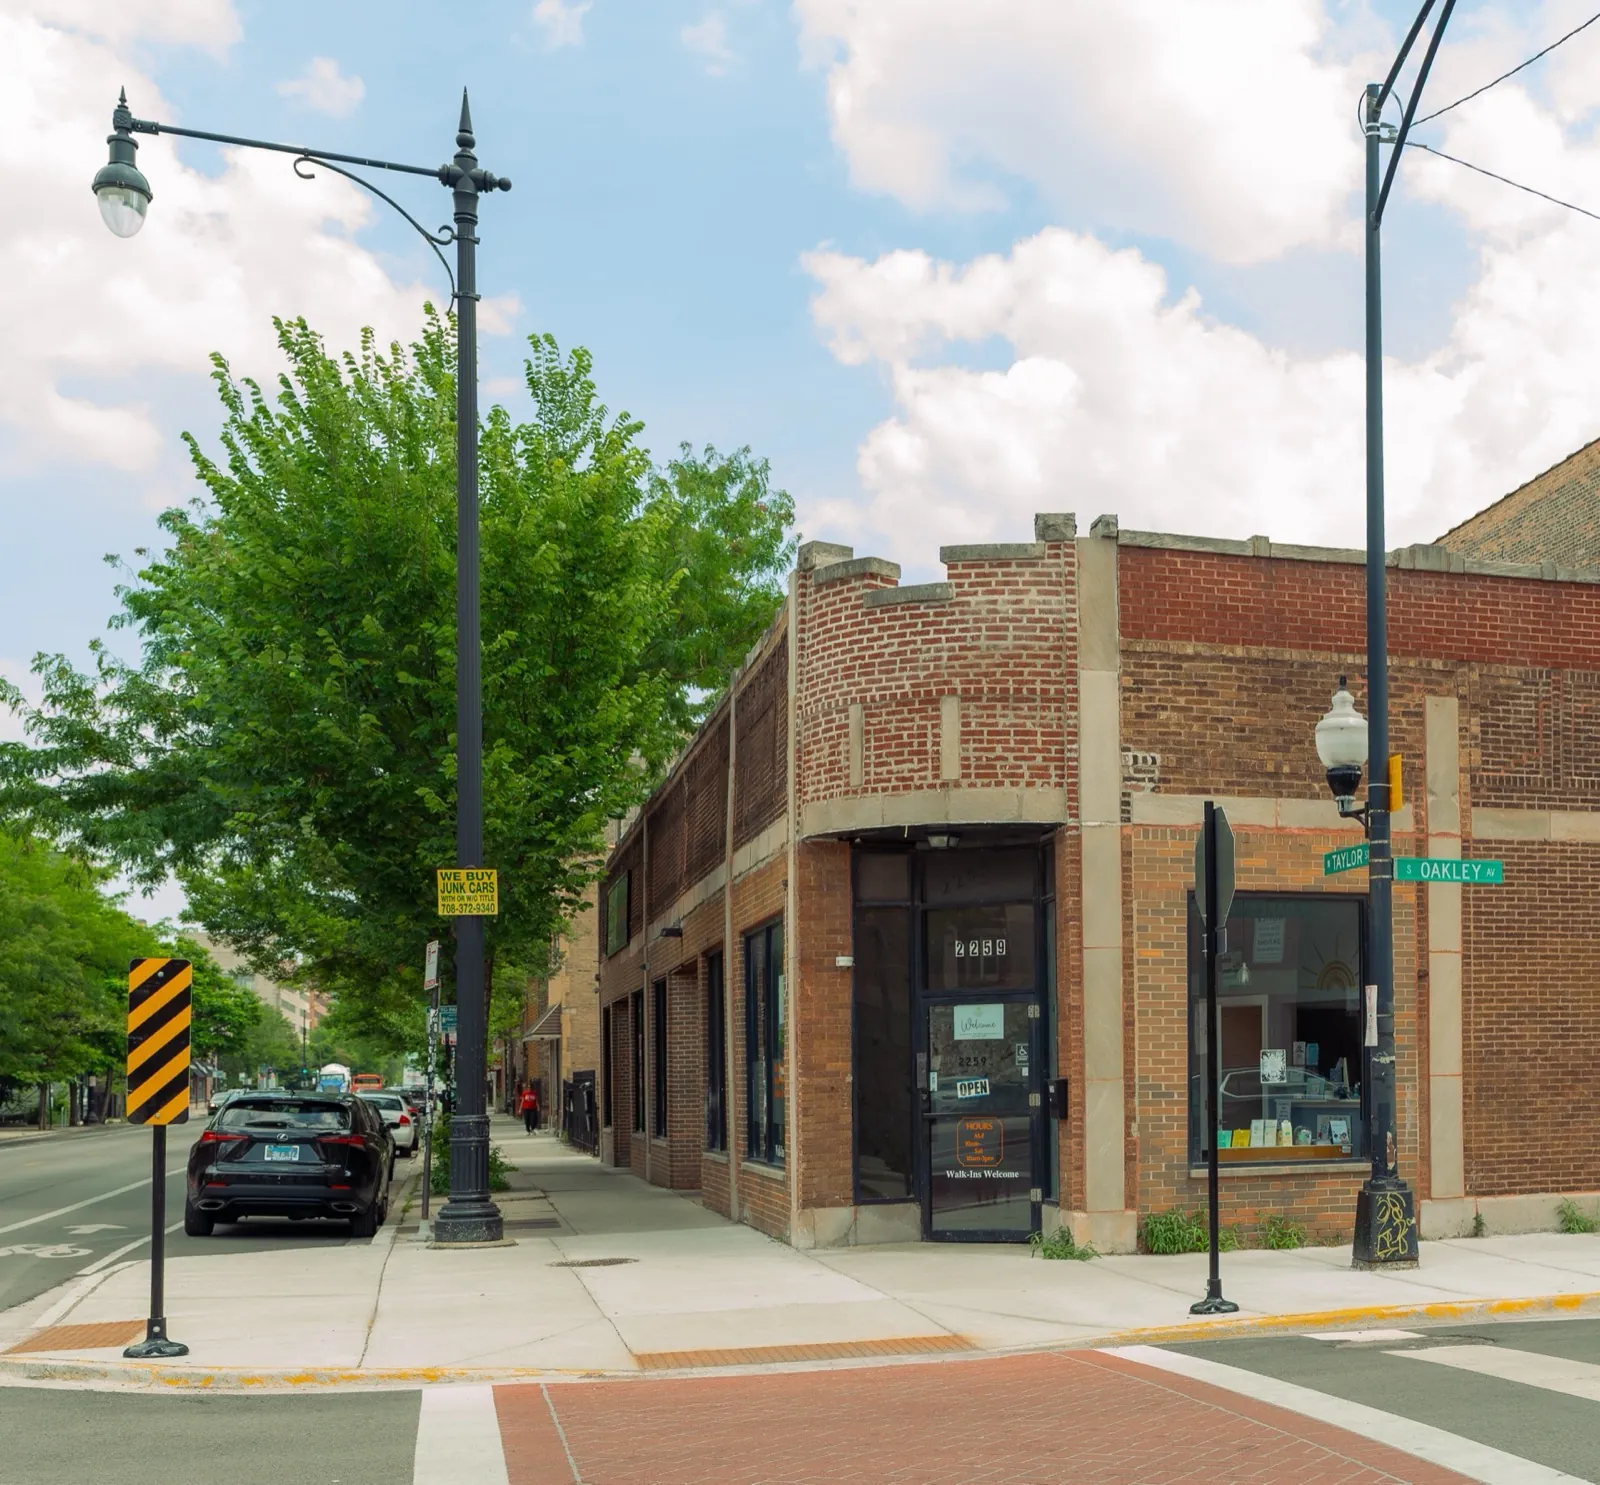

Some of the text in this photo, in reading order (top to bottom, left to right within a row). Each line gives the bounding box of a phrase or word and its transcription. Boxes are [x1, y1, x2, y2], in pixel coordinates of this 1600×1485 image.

[1332, 848, 1363, 871] TAYLOR
[440, 871, 494, 881] WE BUY
[1406, 861, 1496, 880] S OAKLEY AV
[440, 882, 495, 894] JUNK CARS
[479, 894, 495, 902] TITLE
[441, 903, 495, 914] 708-372-9340
[955, 939, 1006, 957] 2259
[960, 1017, 997, 1033] Welcome
[960, 1080, 988, 1097] OPEN
[965, 1122, 993, 1131] HOURS
[946, 1169, 1019, 1178] Walk-Ins Welcome
